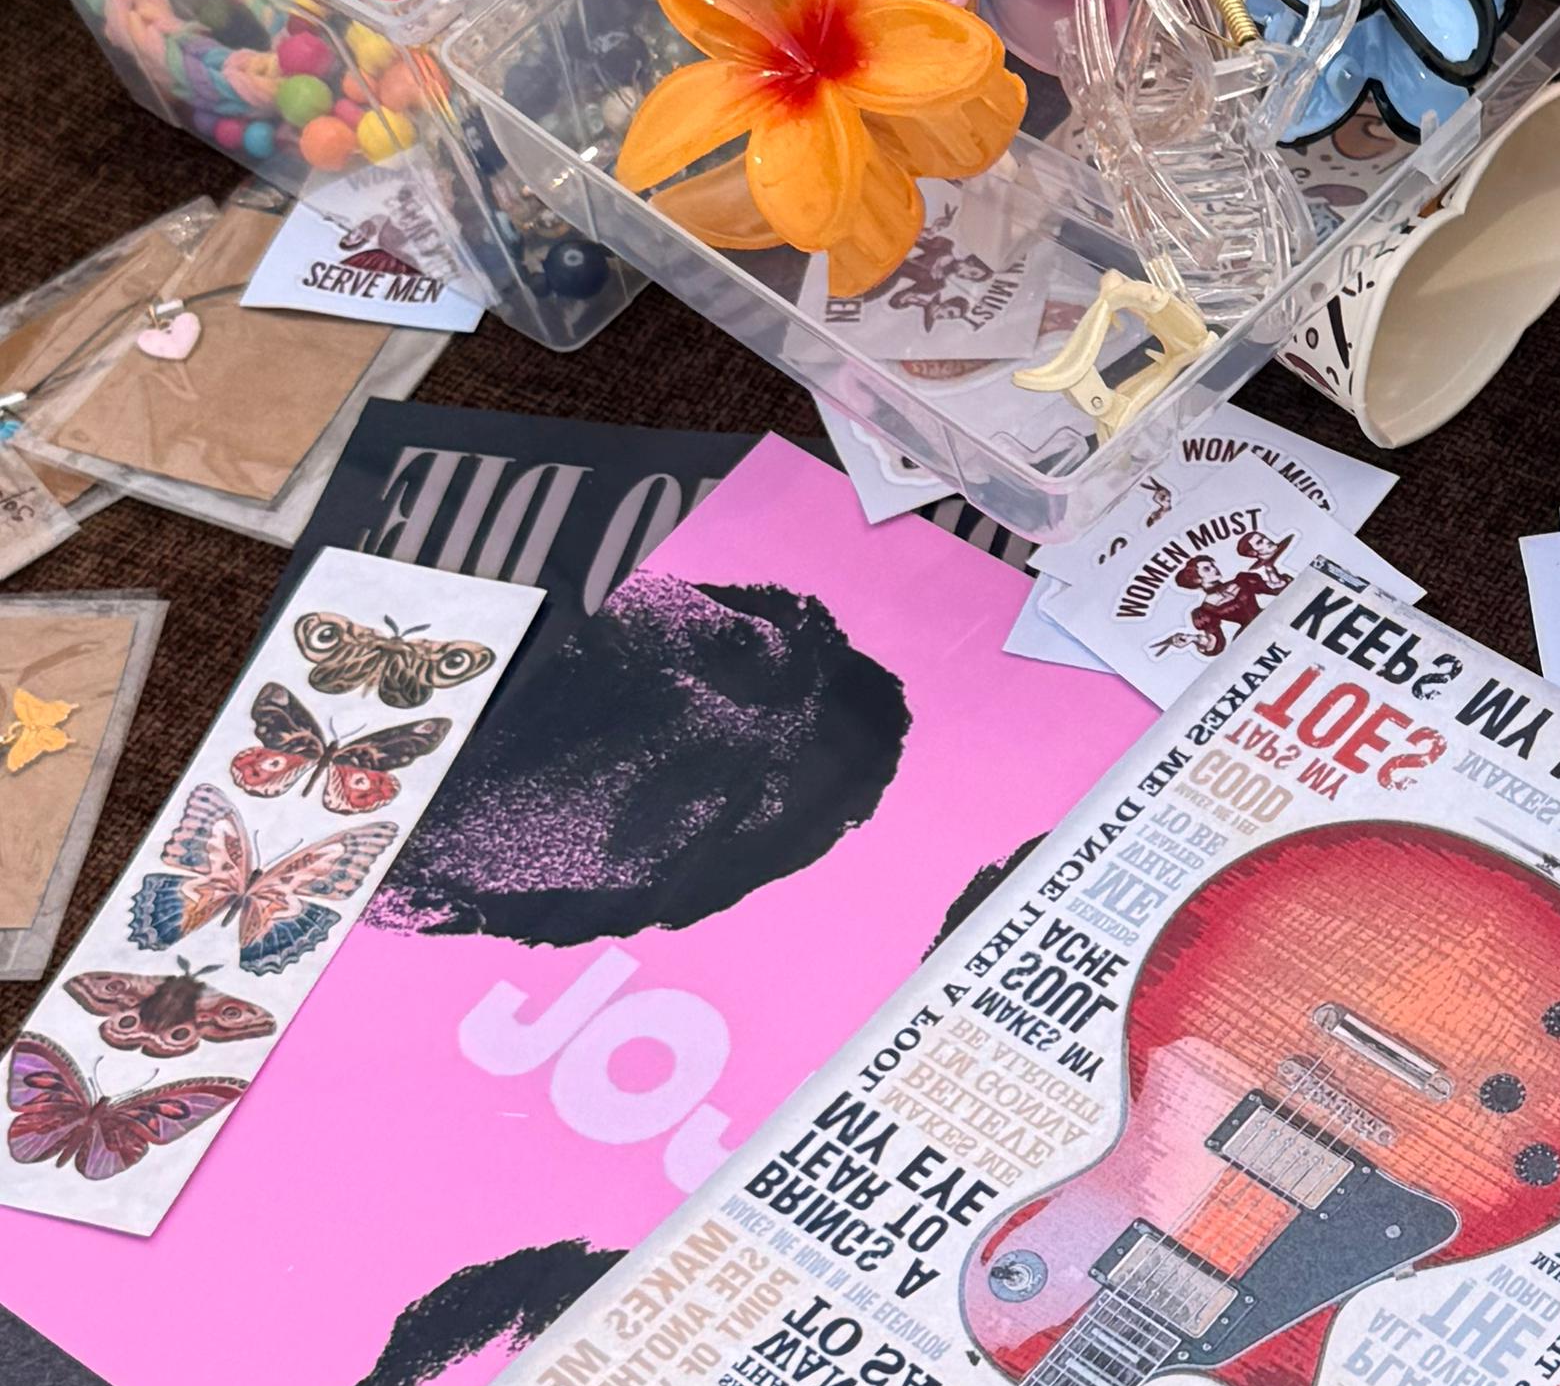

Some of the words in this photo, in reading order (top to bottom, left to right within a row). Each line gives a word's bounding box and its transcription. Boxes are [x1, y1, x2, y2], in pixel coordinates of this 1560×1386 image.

[303, 261, 386, 299] SERVE
[383, 271, 445, 304] MEN
[1116, 540, 1191, 619] WOMEN
[1186, 507, 1263, 552] MUST
